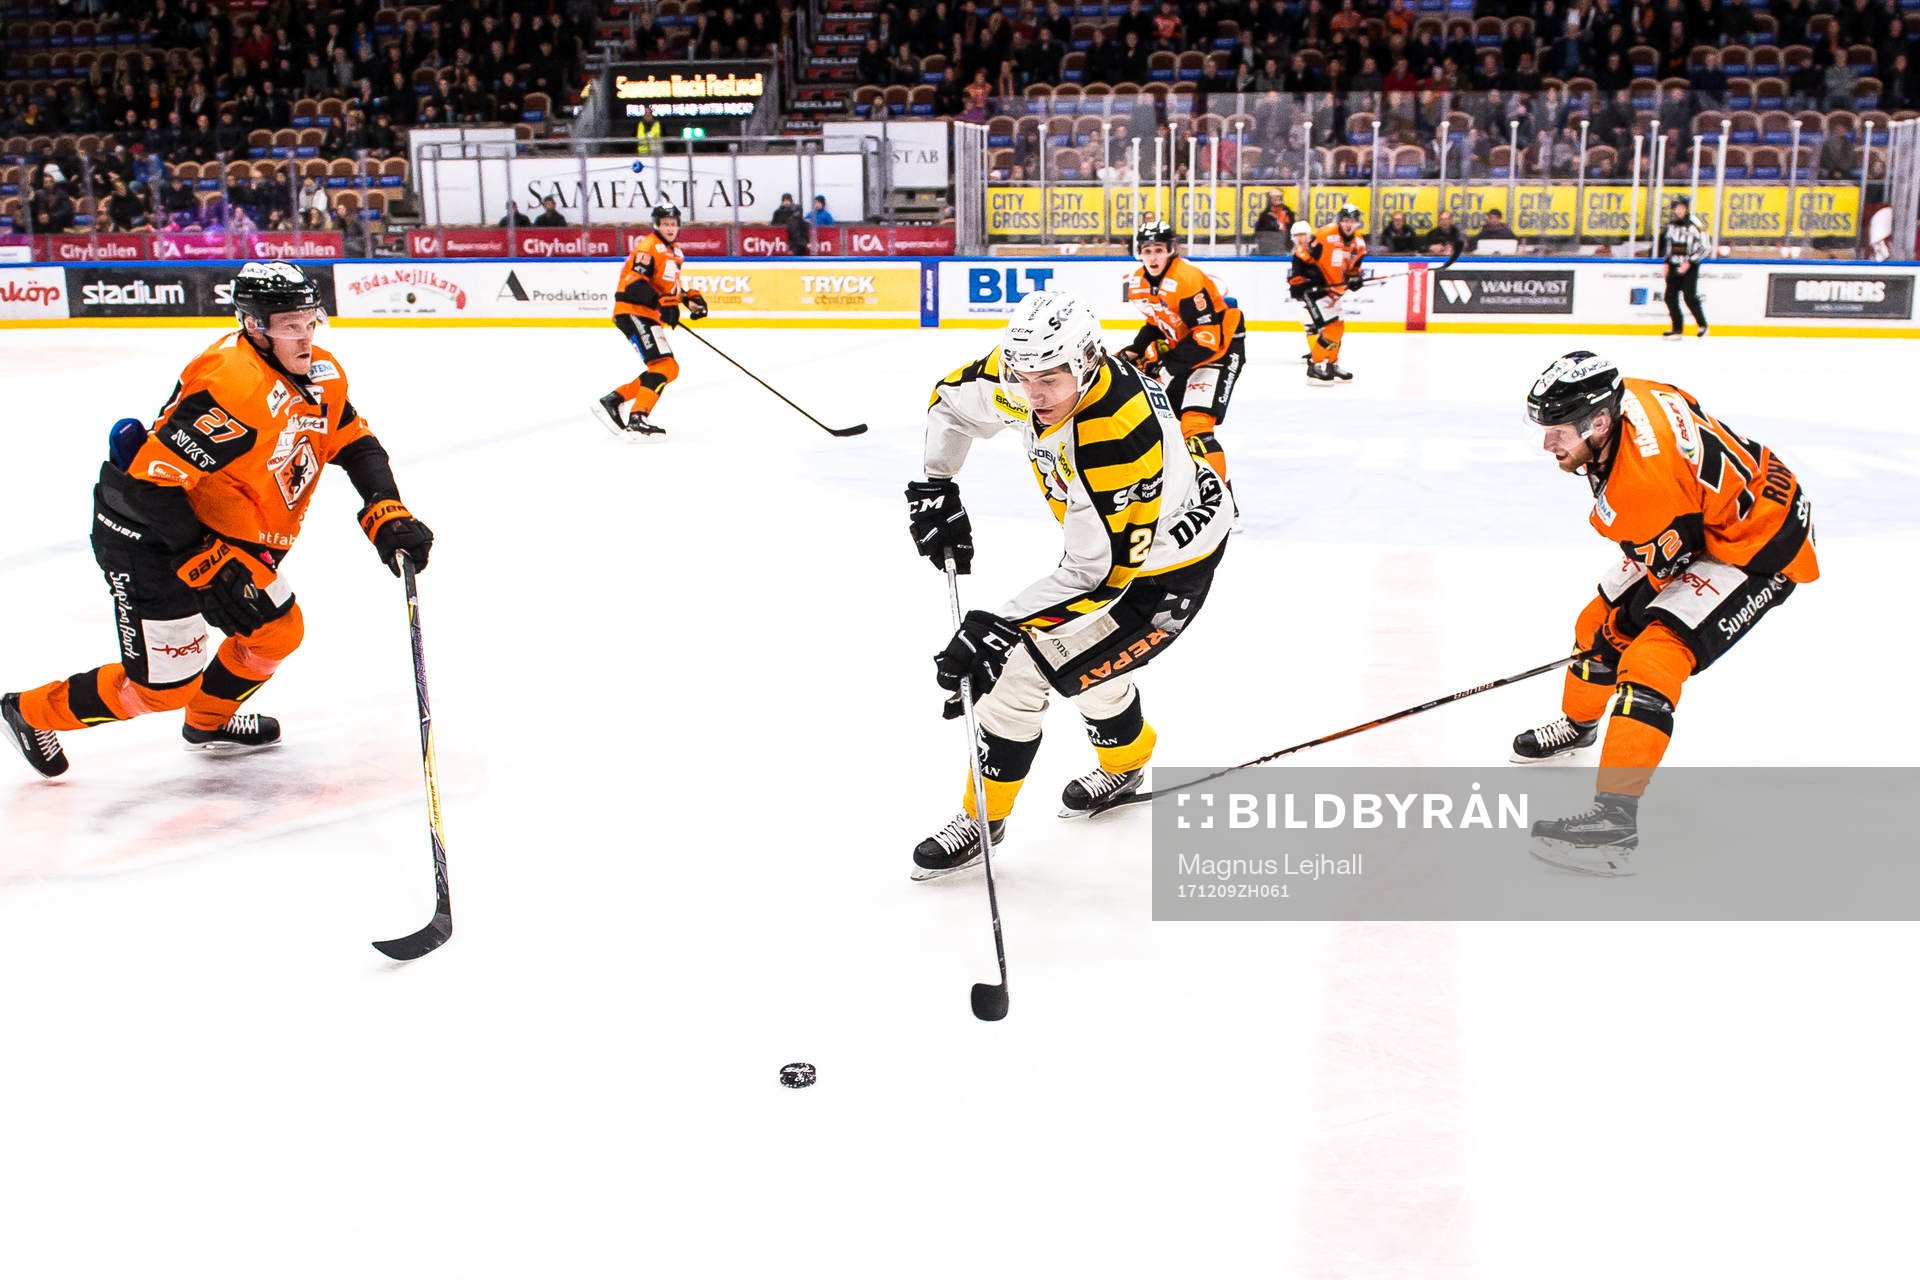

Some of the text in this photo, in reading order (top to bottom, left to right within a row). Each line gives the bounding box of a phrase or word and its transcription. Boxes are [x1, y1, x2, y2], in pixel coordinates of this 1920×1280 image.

[528, 178, 755, 209] SAMFAST AB
[992, 193, 1024, 210] CITY
[1052, 193, 1083, 210] CITY
[1315, 193, 1349, 210] CITY
[1382, 193, 1417, 210] CITY
[1450, 193, 1485, 210] CITY
[1519, 193, 1554, 210] CITY
[1589, 193, 1624, 210] CITY
[1729, 193, 1766, 210] CITY
[1800, 193, 1835, 210] CITY
[992, 212, 1041, 229] GROSS
[1052, 212, 1099, 229] GROSS
[1518, 211, 1571, 230] GROSS
[1728, 212, 1781, 230] GROSS
[1799, 212, 1851, 231] GROSS
[853, 235, 884, 252] ICA
[395, 269, 458, 294] Nejlikan
[681, 275, 752, 293] TRYCK
[800, 275, 876, 294] TRYCK
[969, 268, 1054, 303] BLT
[1481, 280, 1568, 295] WAHLQVIST
[82, 280, 185, 305] stadium
[533, 289, 608, 301] Produktion
[1794, 280, 1886, 302] BROTHERS
[194, 407, 248, 443] 27
[171, 429, 216, 468] NKT
[97, 512, 142, 541] BAUER
[1634, 529, 1683, 566] 72
[1718, 587, 1773, 640] Sweden
[1079, 628, 1170, 690] REPAY
